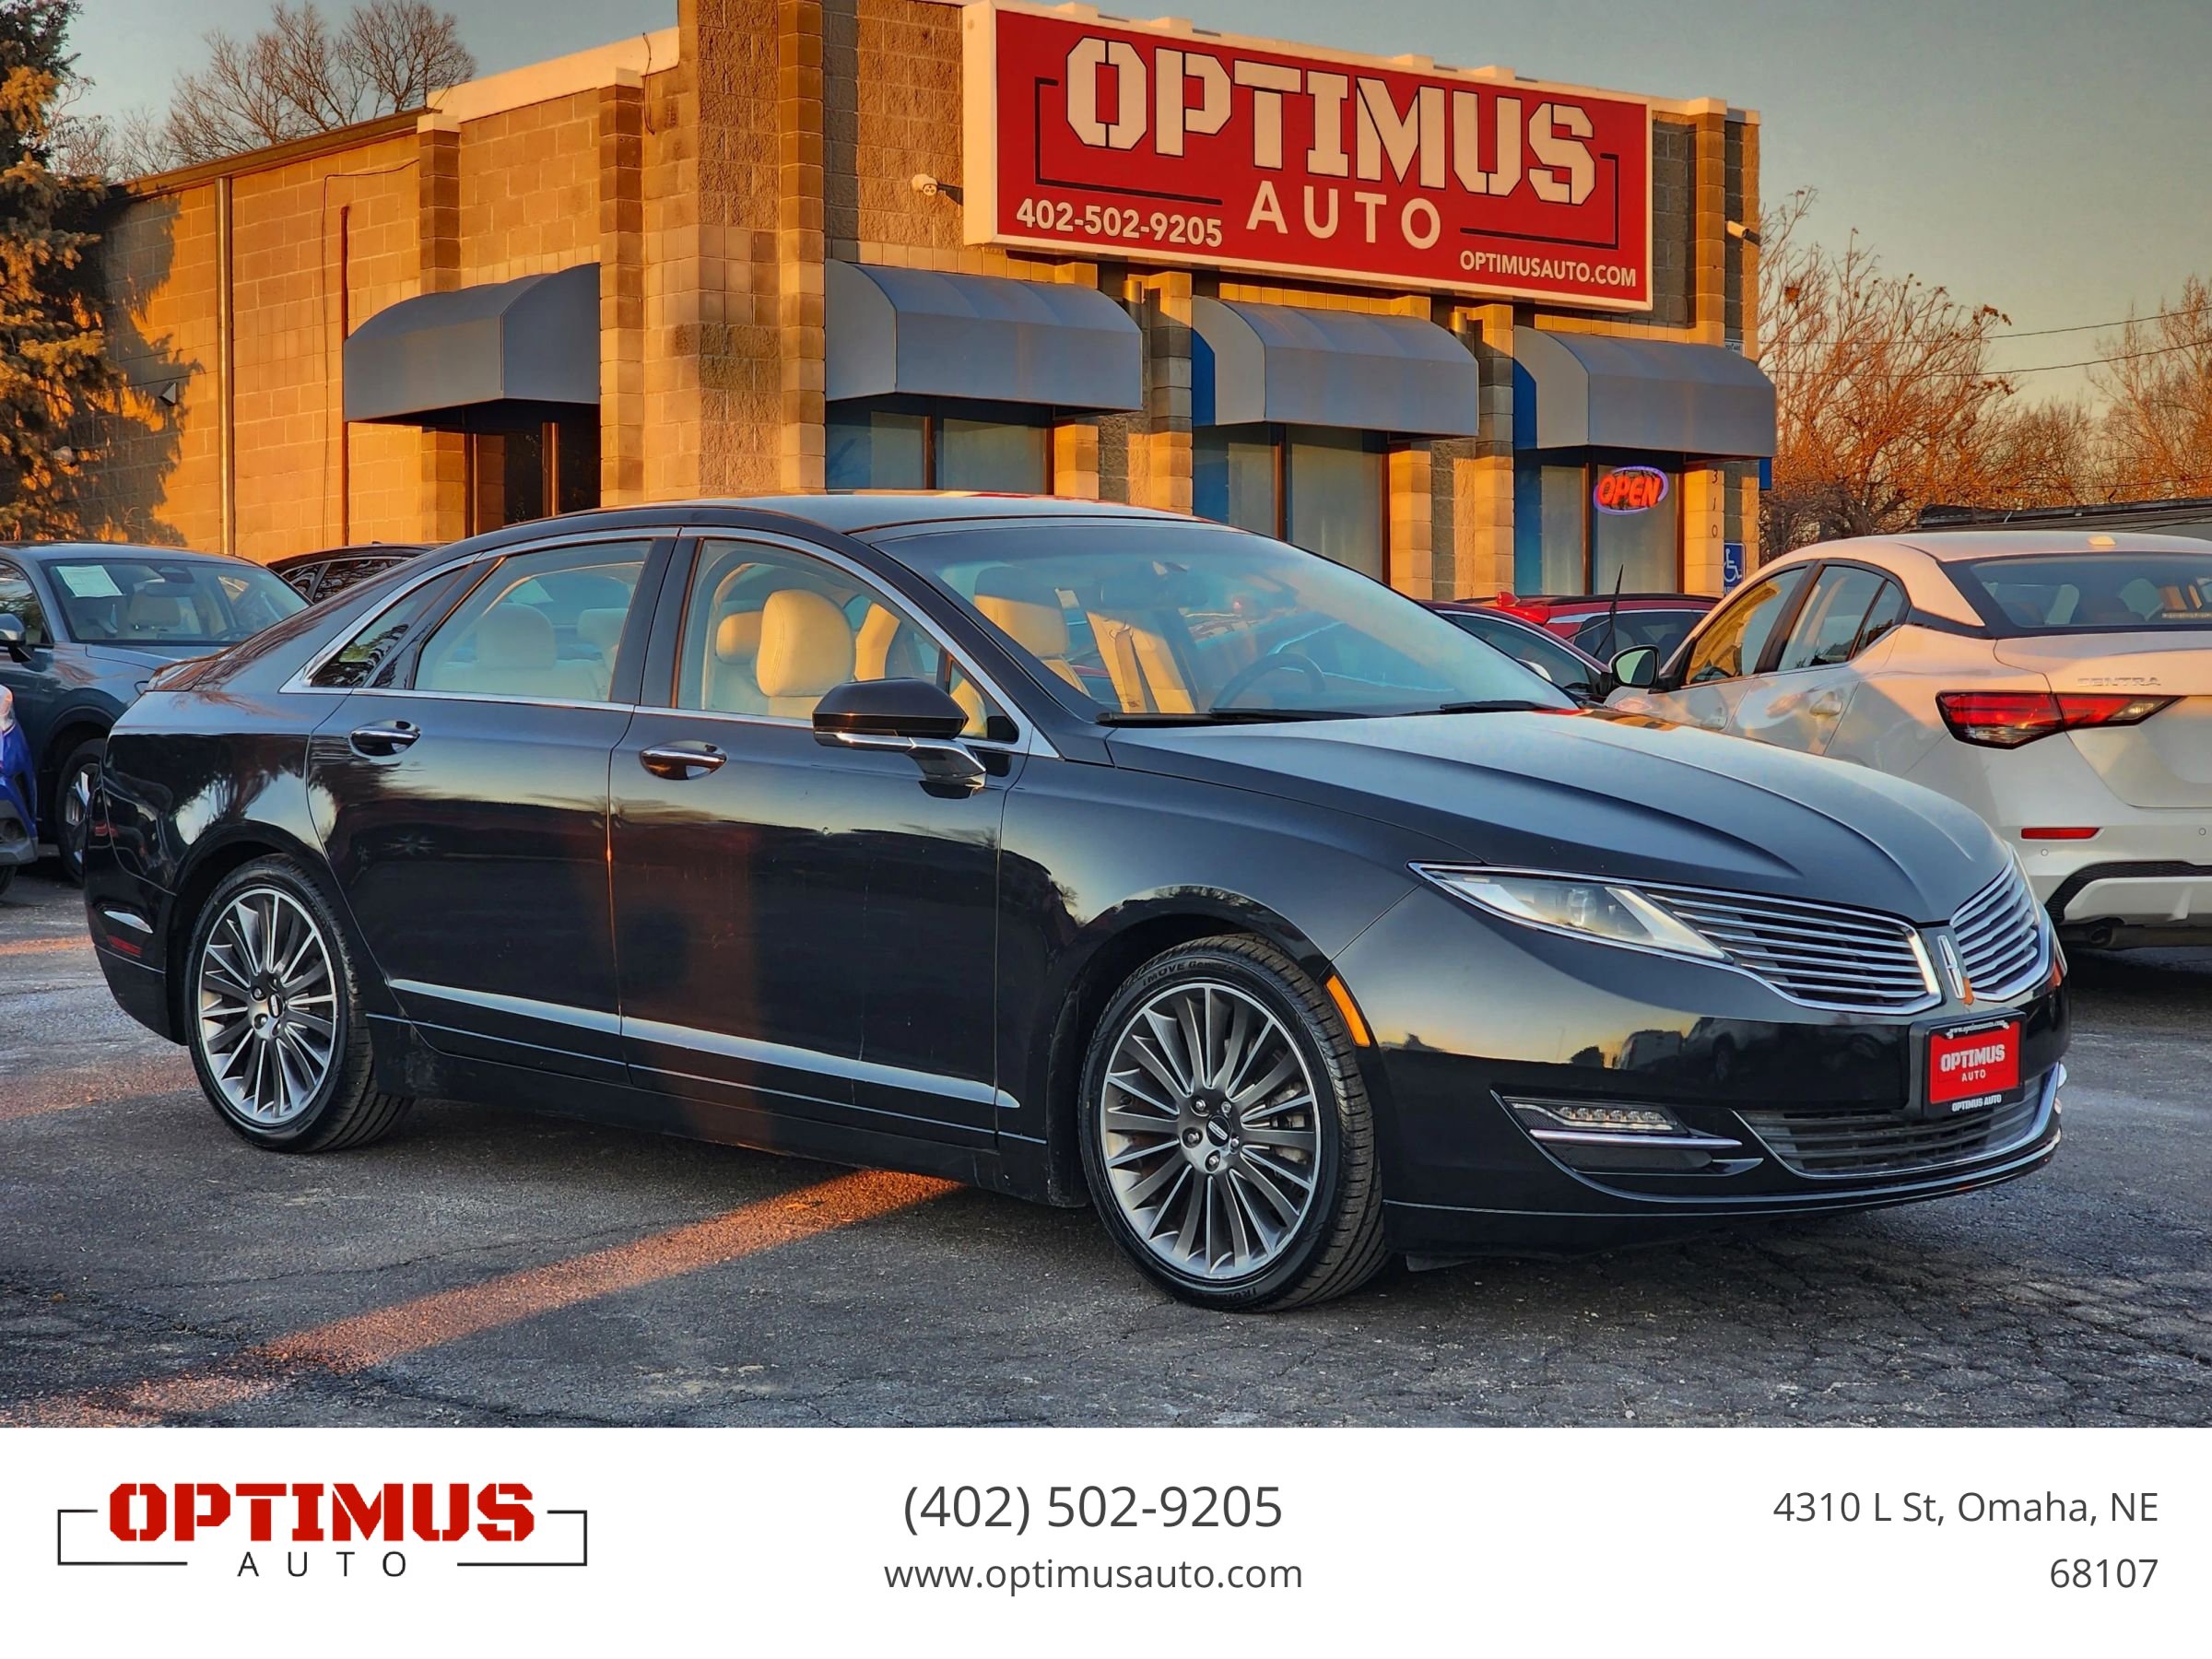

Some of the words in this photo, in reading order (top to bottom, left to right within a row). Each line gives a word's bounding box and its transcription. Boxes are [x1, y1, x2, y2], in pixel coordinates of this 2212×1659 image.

[1066, 36, 1596, 206] OPTIMUS
[1016, 197, 1223, 248] 402-502-9205
[1246, 181, 1441, 250] AUTO
[1459, 249, 1637, 288] OPTIMUSAUTO.COM
[1597, 472, 1662, 509] OPEN
[1940, 1044, 2006, 1072] OPTIMUS
[1961, 1069, 1986, 1082] AUTO
[1951, 1098, 1983, 1112] OPTIMUS
[1983, 1094, 2002, 1107] AUTO
